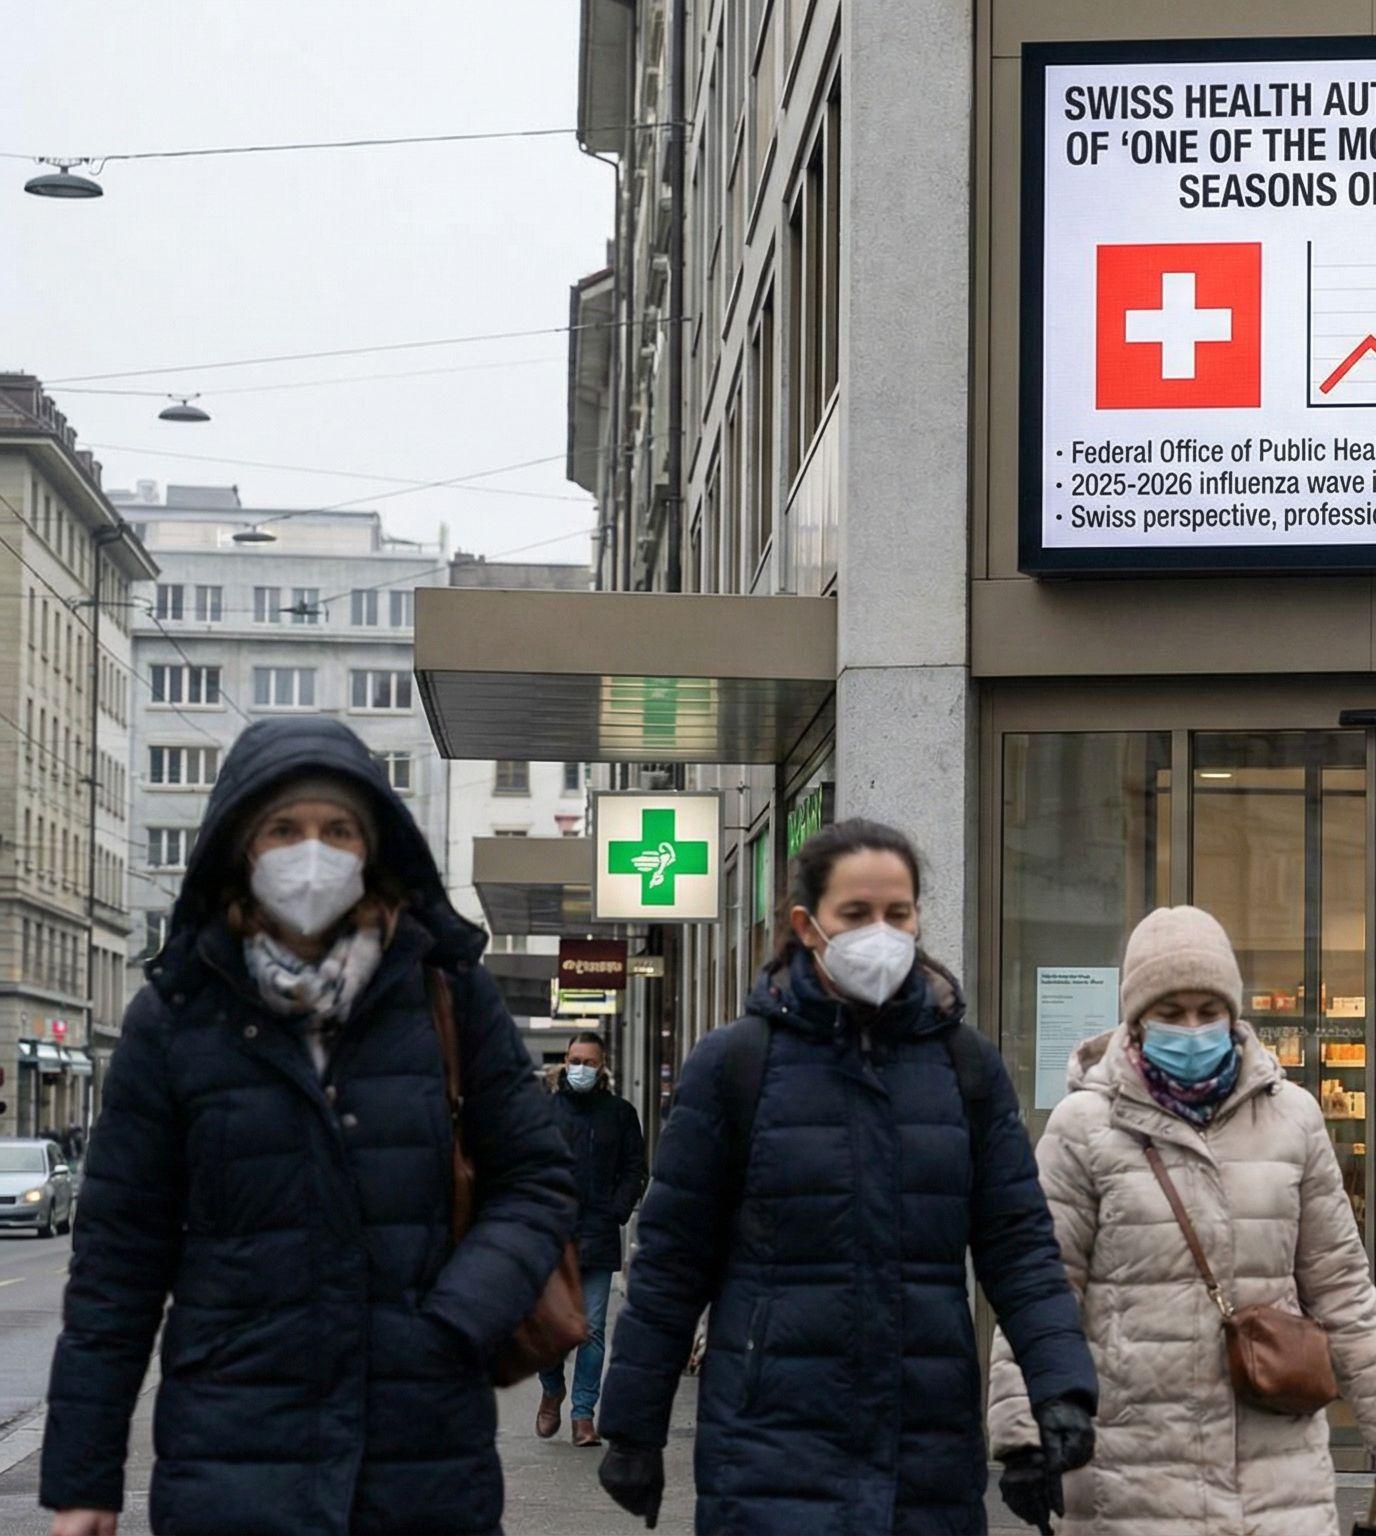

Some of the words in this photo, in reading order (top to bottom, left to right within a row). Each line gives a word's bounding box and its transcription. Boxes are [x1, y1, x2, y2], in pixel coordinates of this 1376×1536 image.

[1064, 84, 1174, 121] SWISS
[1185, 82, 1312, 119] HEALTH
[1066, 131, 1110, 166] OF
[1209, 128, 1253, 164] OF
[1262, 127, 1327, 162] THE
[1179, 172, 1337, 209] SEASONS
[1072, 439, 1152, 464] Federal
[1160, 438, 1224, 463] Office
[1230, 438, 1252, 463] of
[1259, 437, 1326, 462] Public
[1071, 472, 1192, 497] 2025-2026
[1200, 470, 1300, 495] influenza
[1306, 475, 1365, 494] wave
[1071, 504, 1136, 529] Swiss
[1143, 502, 1277, 533] perspective,
